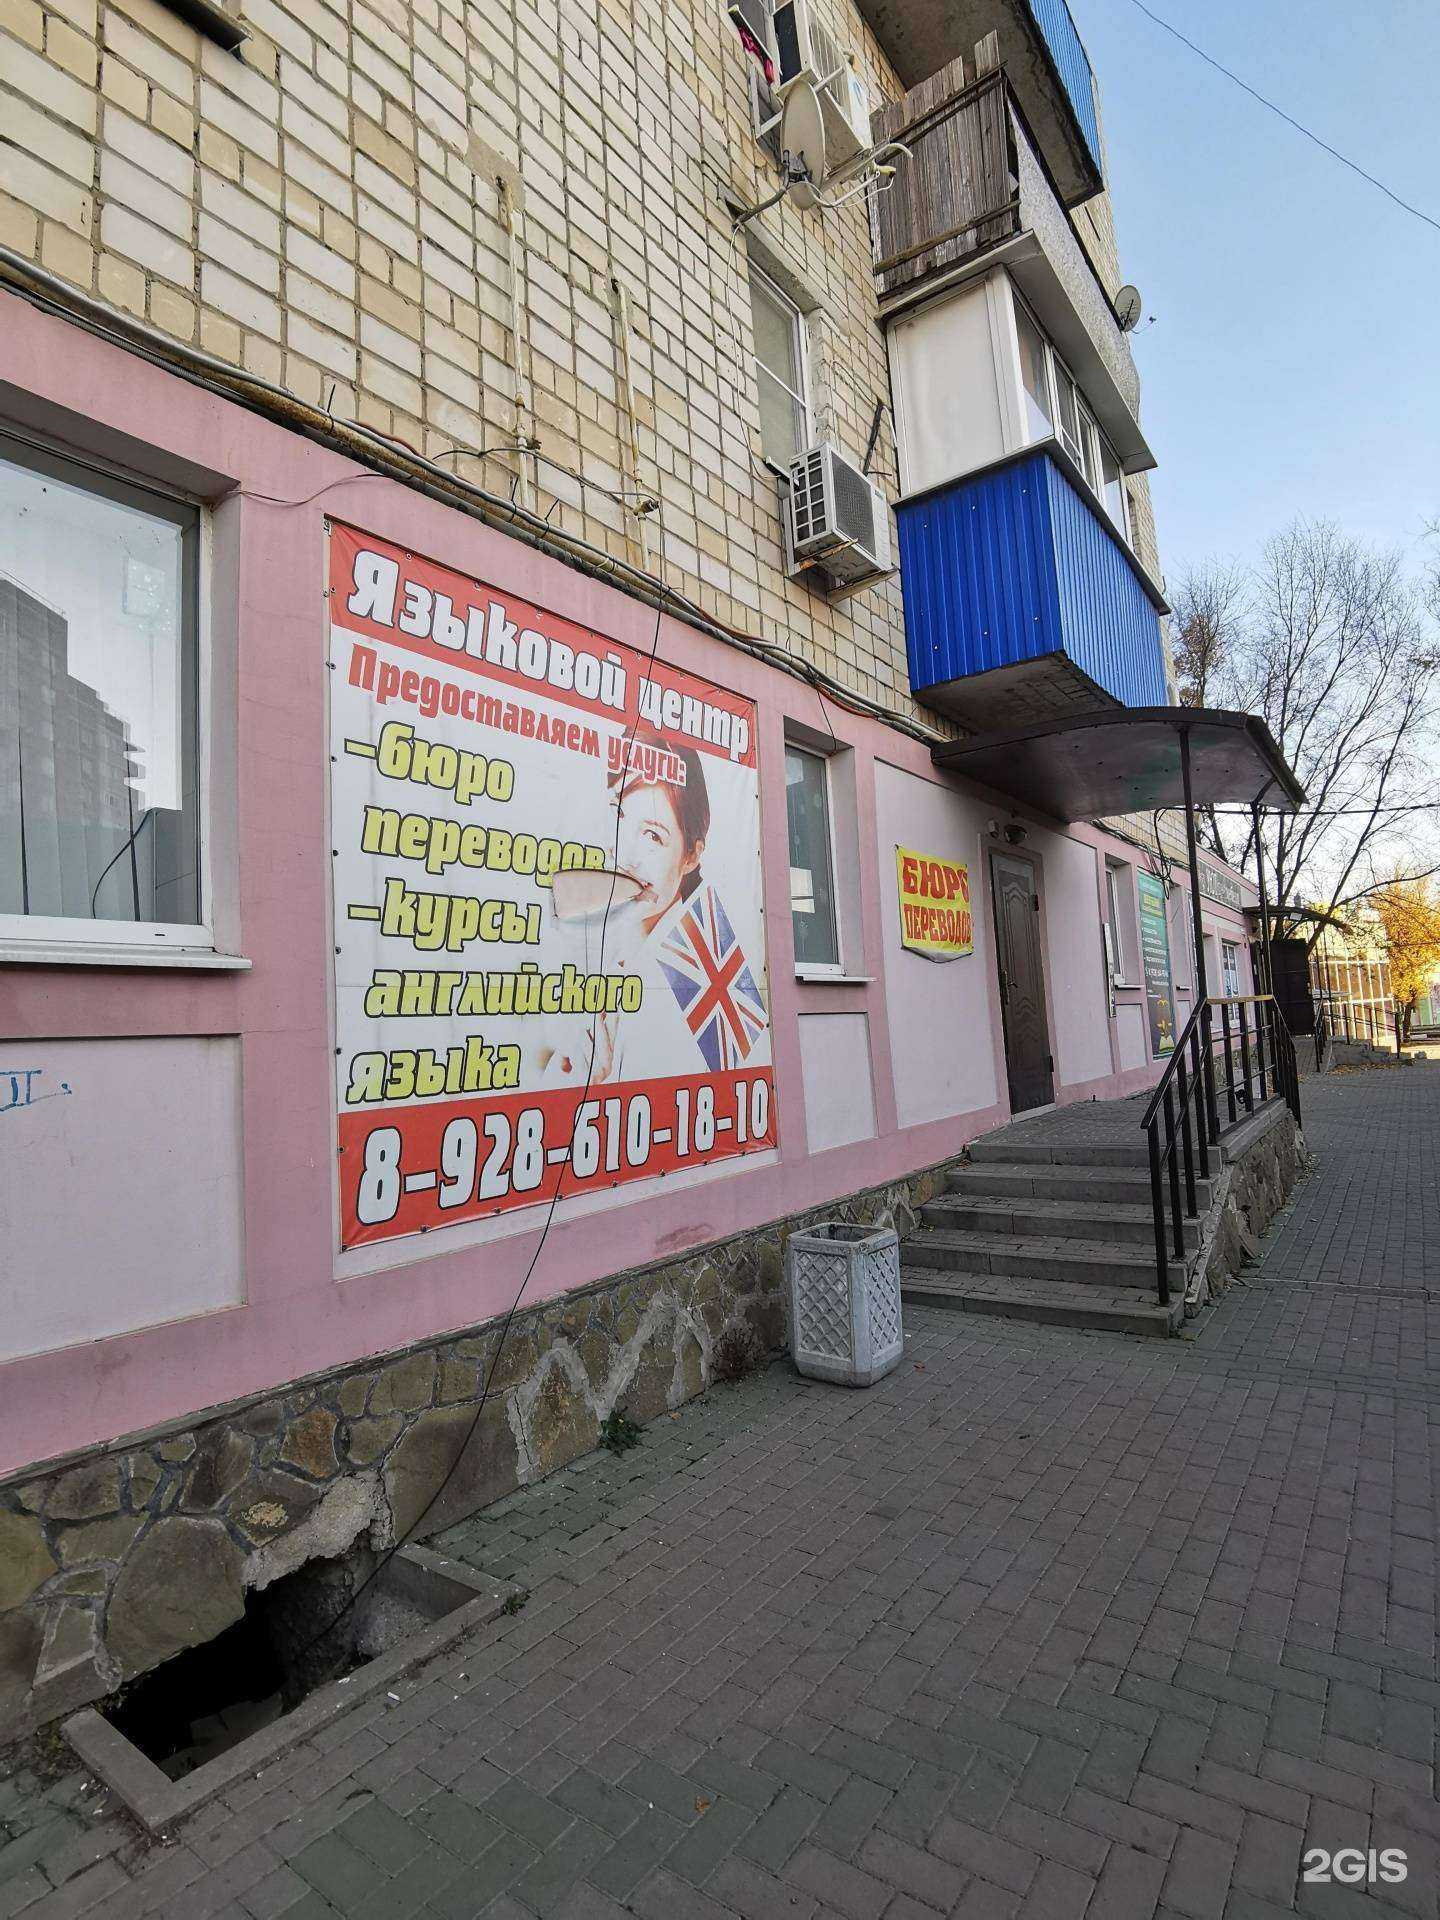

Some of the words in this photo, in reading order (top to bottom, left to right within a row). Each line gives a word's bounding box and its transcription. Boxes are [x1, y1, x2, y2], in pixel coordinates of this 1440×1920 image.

[346, 548, 627, 712] Языковой
[638, 676, 751, 764] центр
[348, 643, 600, 758] Предоставляем
[606, 737, 687, 786] услуги:
[364, 962, 643, 1018] английского
[345, 1035, 521, 1104] языка
[356, 1078, 769, 1227] 8-928-610-18-10
